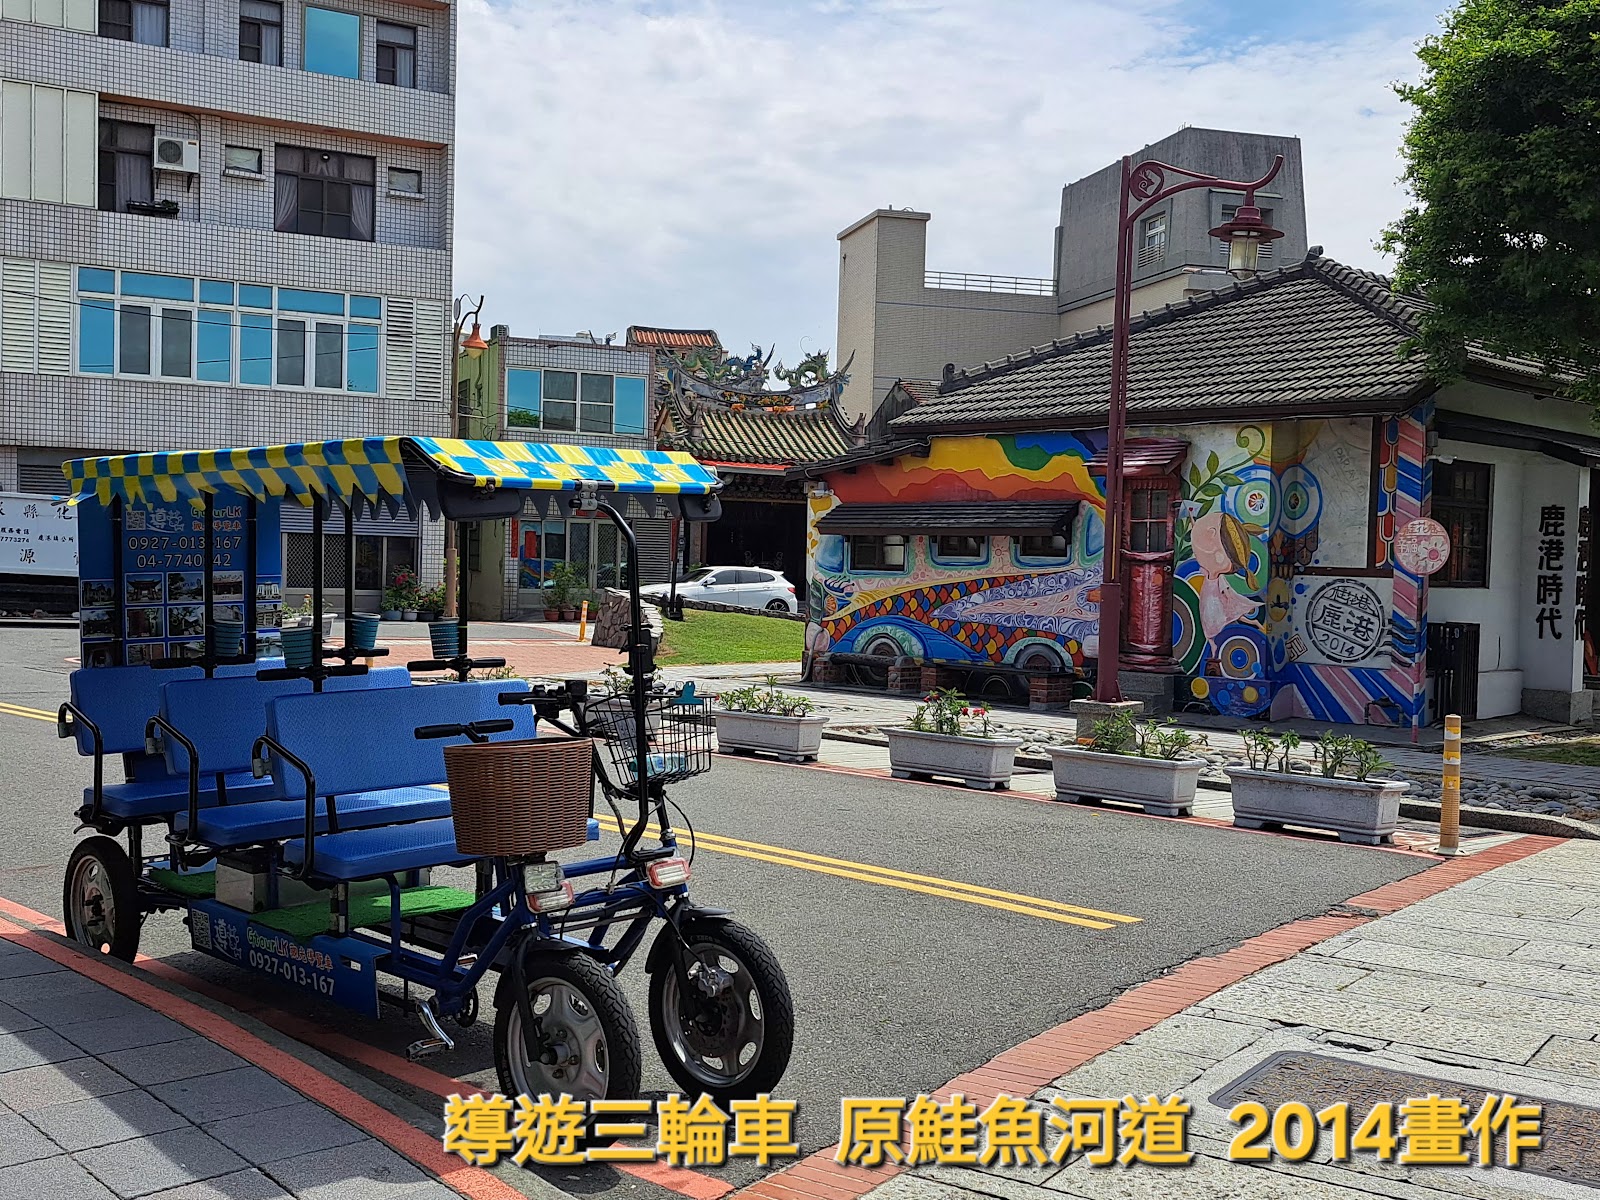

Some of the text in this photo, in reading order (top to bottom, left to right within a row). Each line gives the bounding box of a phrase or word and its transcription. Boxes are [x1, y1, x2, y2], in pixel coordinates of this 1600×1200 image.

[128, 536, 242, 550] 0927-013167
[137, 554, 231, 568] 04-774042
[1535, 504, 1566, 640] 鹿港時代
[1313, 603, 1375, 642] 鹿港
[1319, 633, 1355, 657] 2014
[250, 949, 335, 996] 0927-013-167
